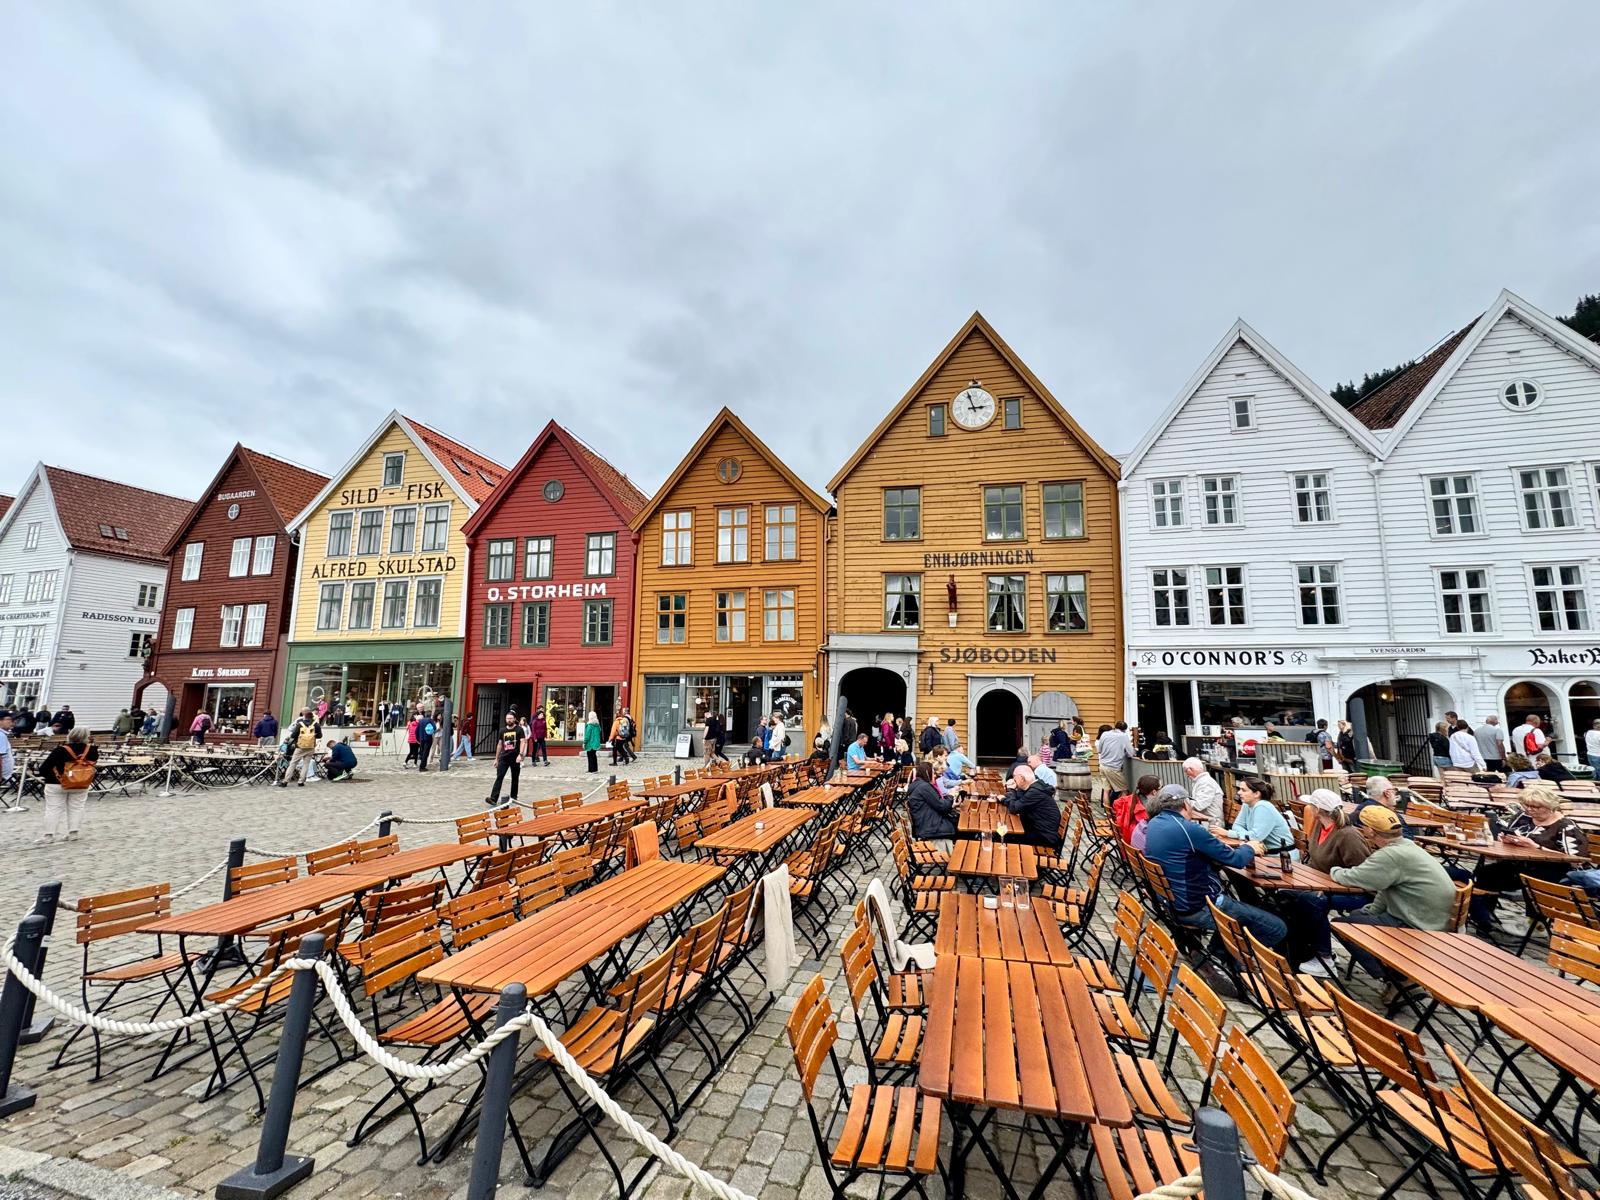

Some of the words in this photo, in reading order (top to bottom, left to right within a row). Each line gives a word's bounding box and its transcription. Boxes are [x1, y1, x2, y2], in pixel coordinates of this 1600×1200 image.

[217, 490, 256, 501] BUGAARDEN
[341, 488, 378, 505] SILD
[407, 482, 444, 500] FISK
[924, 550, 1034, 568] ENHJØRNINGEN
[311, 561, 367, 579] ALFRED
[378, 556, 456, 575] SKULSTAD
[487, 587, 504, 601] O.
[507, 582, 607, 600] STORHEIM
[82, 611, 134, 623] RADISSON
[940, 647, 1057, 663] SJØBODEN
[1162, 651, 1285, 666] O'CONNOR'S
[13, 668, 45, 677] GALLERY
